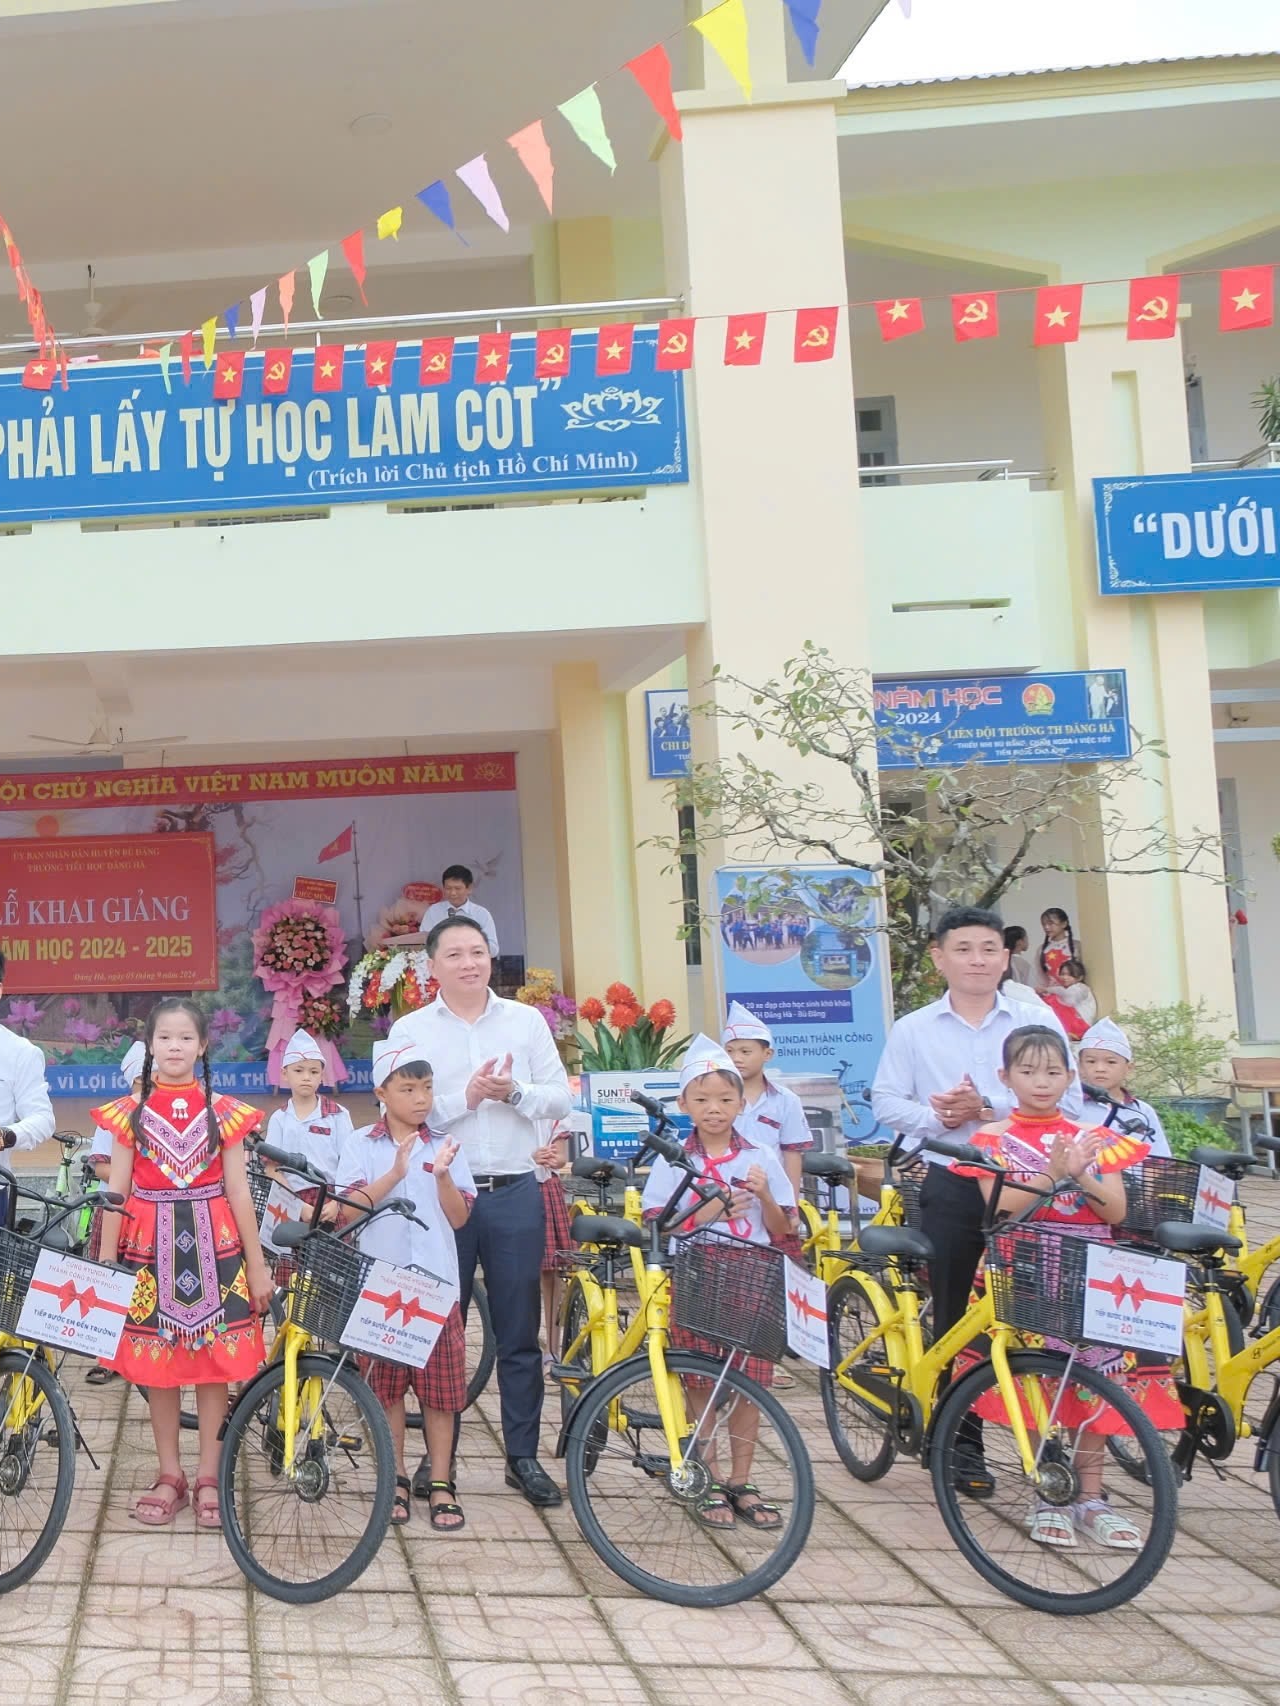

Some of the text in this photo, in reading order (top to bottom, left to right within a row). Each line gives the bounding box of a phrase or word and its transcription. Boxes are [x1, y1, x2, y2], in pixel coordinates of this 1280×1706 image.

[91, 389, 166, 475] LẤY
[179, 400, 236, 481] TỰ
[246, 399, 332, 478] HỌC
[346, 385, 441, 459] LÀM
[308, 450, 638, 491] (Trích lời Chủ tịch Hồ Chí Minh)
[1133, 496, 1276, 559] “DƯỚI
[874, 685, 1002, 710] NĂM HỌC
[894, 712, 942, 725] 2024
[32, 775, 87, 799] CHỦ
[94, 771, 178, 797] NGHĨA
[183, 771, 242, 797] VIỆT
[249, 770, 309, 791] NAM
[315, 763, 397, 789] MUÔN
[402, 761, 465, 784] NĂM
[27, 899, 96, 925] KHAI
[102, 888, 190, 922] GIẢNG
[36, 937, 73, 964] HỌC
[80, 937, 127, 960] 2024
[145, 936, 192, 958] 2025
[773, 1034, 810, 1044] YUNDAI
[844, 1031, 873, 1043] CÔNG
[57, 1072, 128, 1093] VÌ LỢI ÍC
[211, 1071, 236, 1087] ĂM
[33, 1307, 47, 1317] TIẾP
[47, 1311, 65, 1323] BƯỚC
[76, 1317, 88, 1330] ĐẾN
[90, 1324, 116, 1338] TRƯỜNG
[60, 1326, 75, 1337] 20
[381, 1334, 395, 1345] 20
